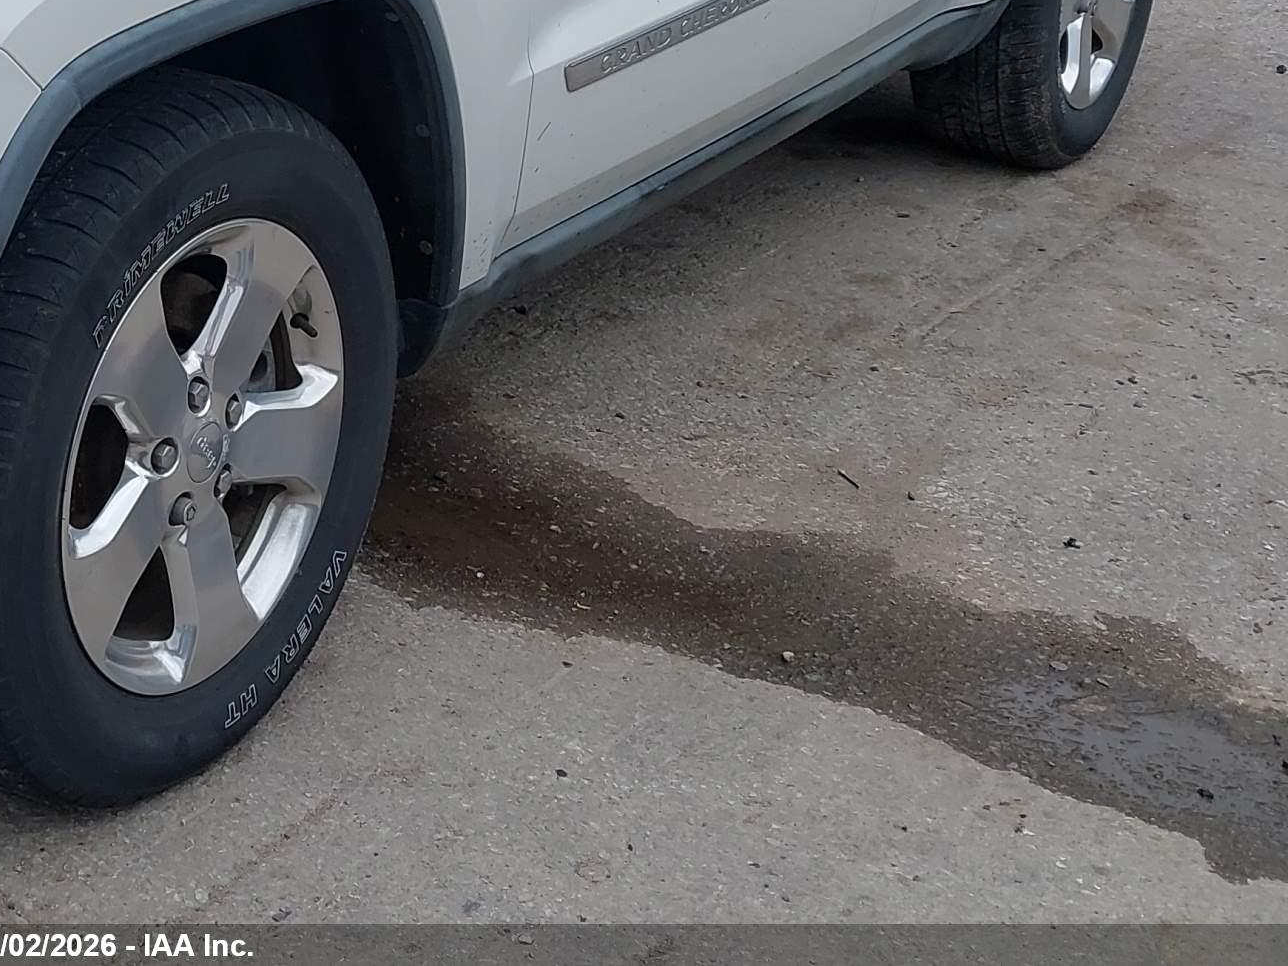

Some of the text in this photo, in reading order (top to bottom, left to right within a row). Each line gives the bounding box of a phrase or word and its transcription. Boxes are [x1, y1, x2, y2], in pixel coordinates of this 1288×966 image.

[600, 27, 672, 74] GRAND
[92, 183, 230, 349] PRIMEWELL
[224, 550, 347, 730] VALERA HT
